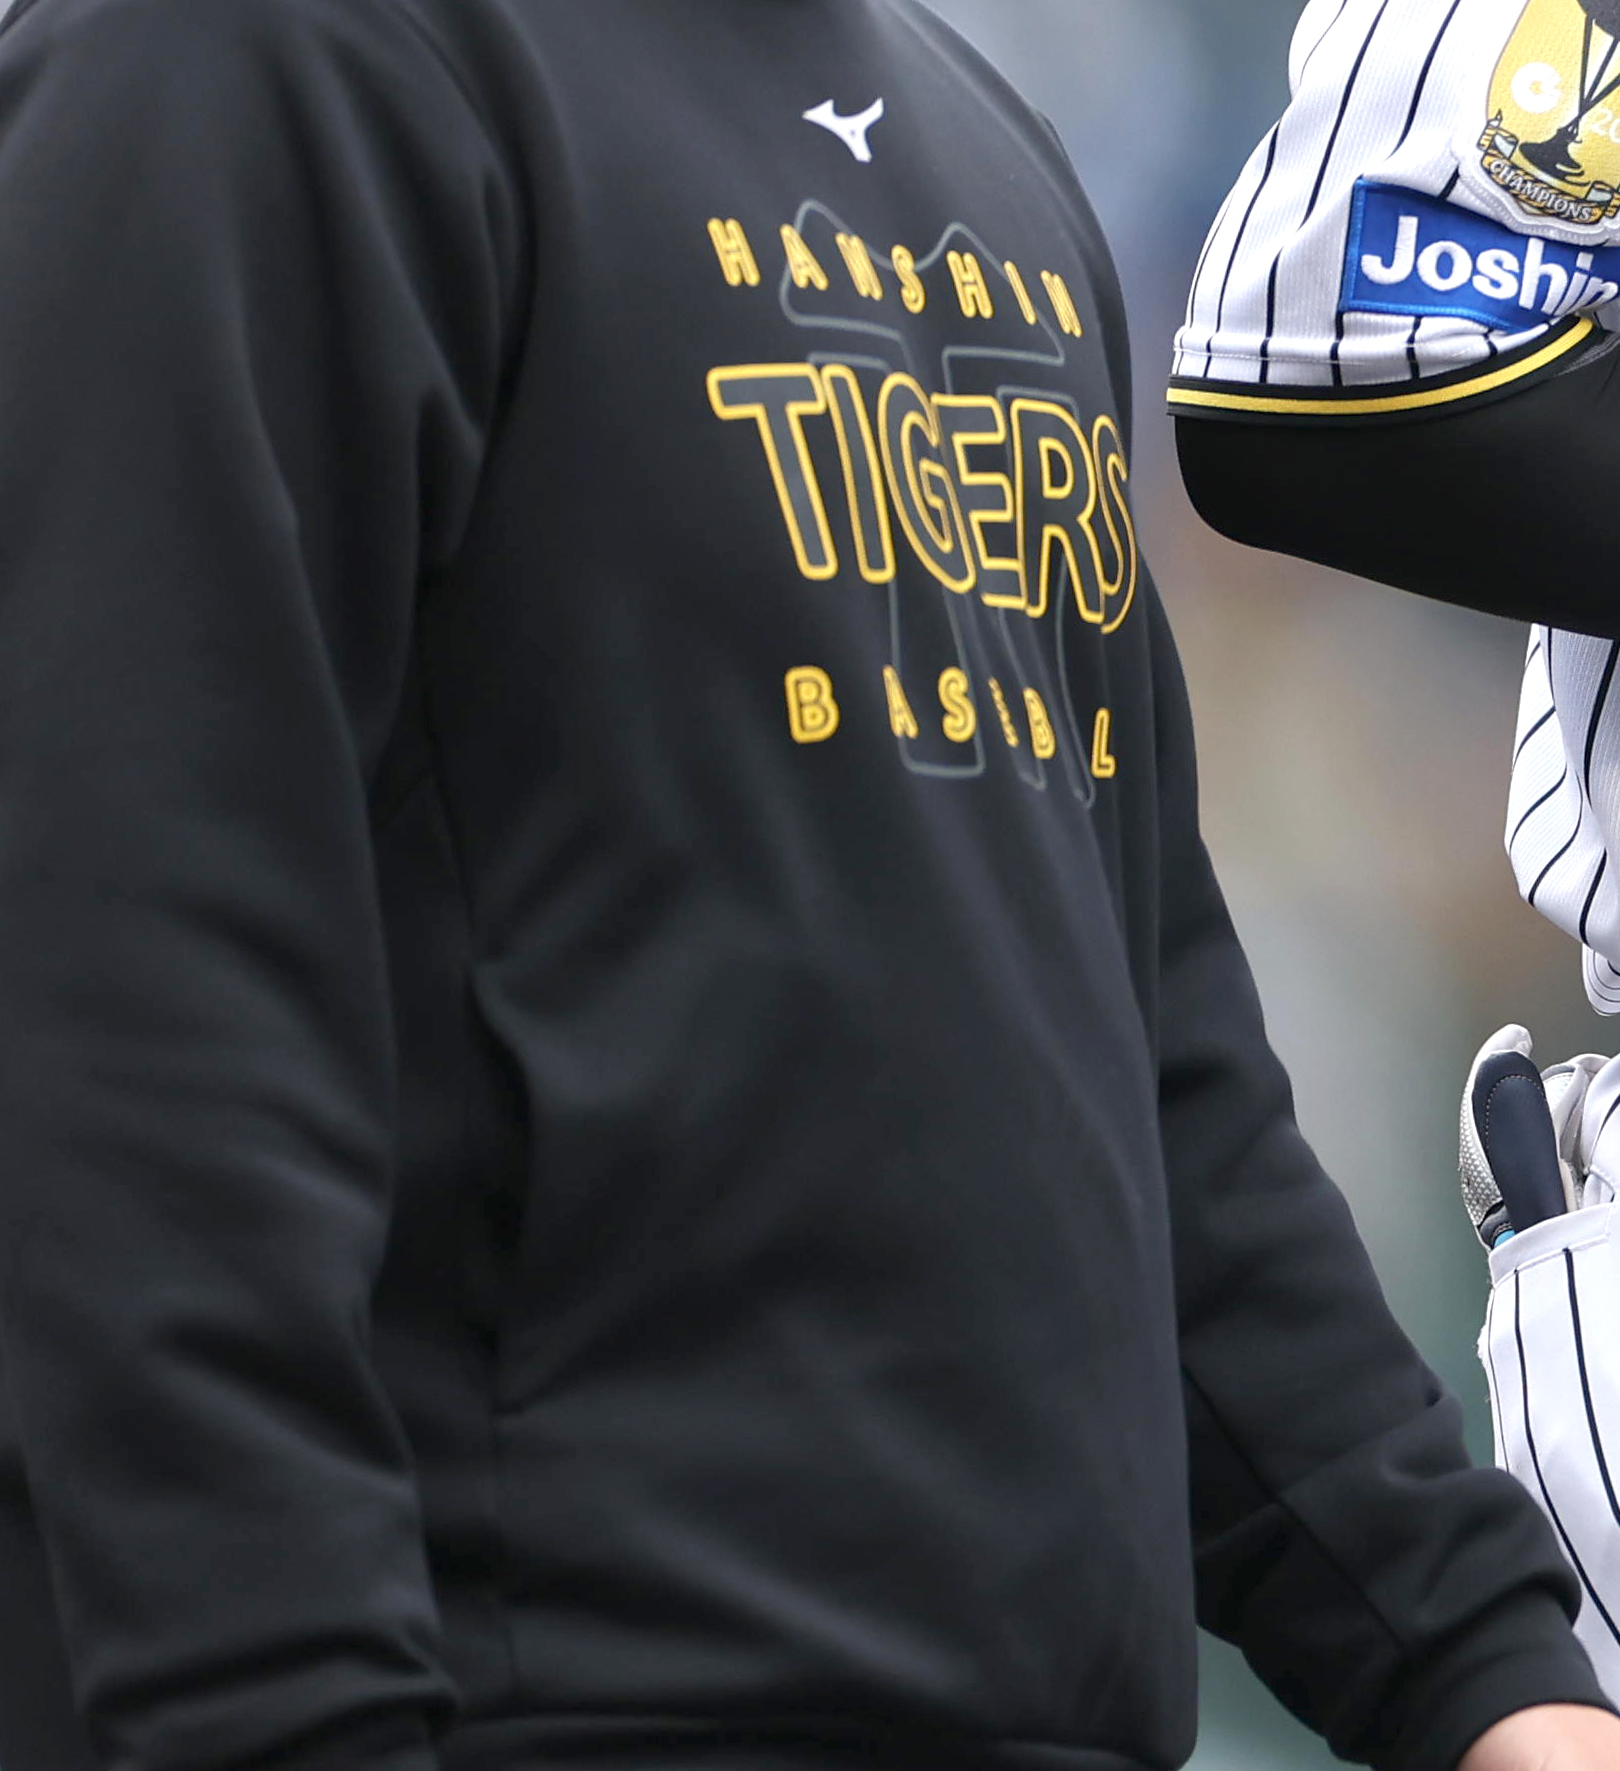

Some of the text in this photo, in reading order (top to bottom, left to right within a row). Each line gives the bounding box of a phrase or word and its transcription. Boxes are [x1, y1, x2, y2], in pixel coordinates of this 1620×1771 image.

[1490, 158, 1592, 221] CHAMPIONS
[706, 217, 1083, 338] HANSHIN
[1360, 215, 1619, 317] Joshin
[706, 362, 1137, 634] TIGERS
